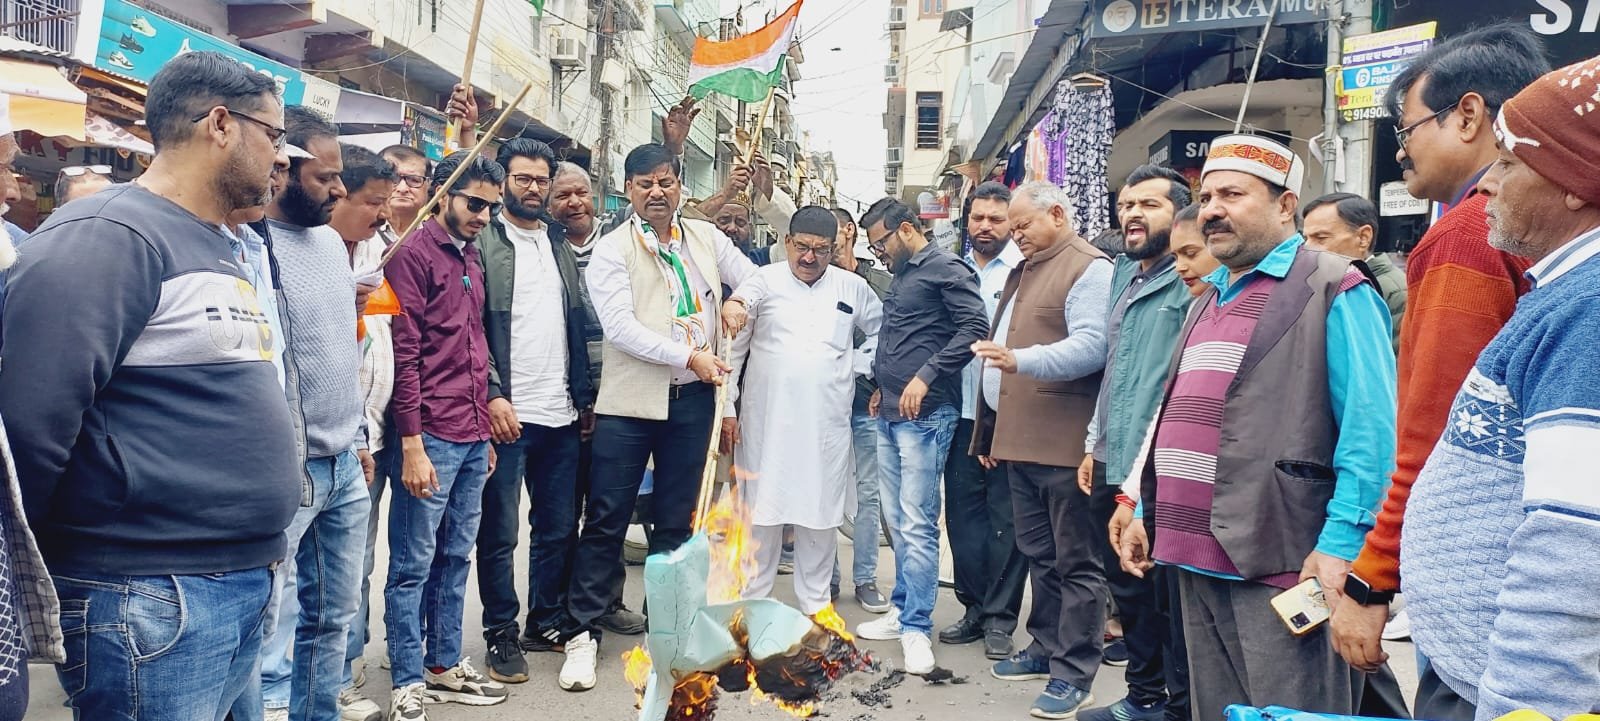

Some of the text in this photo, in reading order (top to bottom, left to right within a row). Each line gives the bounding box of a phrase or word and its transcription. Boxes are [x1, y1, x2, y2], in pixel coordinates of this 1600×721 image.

[1173, 0, 1270, 23] TERA
[312, 94, 331, 109] LUCKY
[1185, 142, 1209, 158] SA
